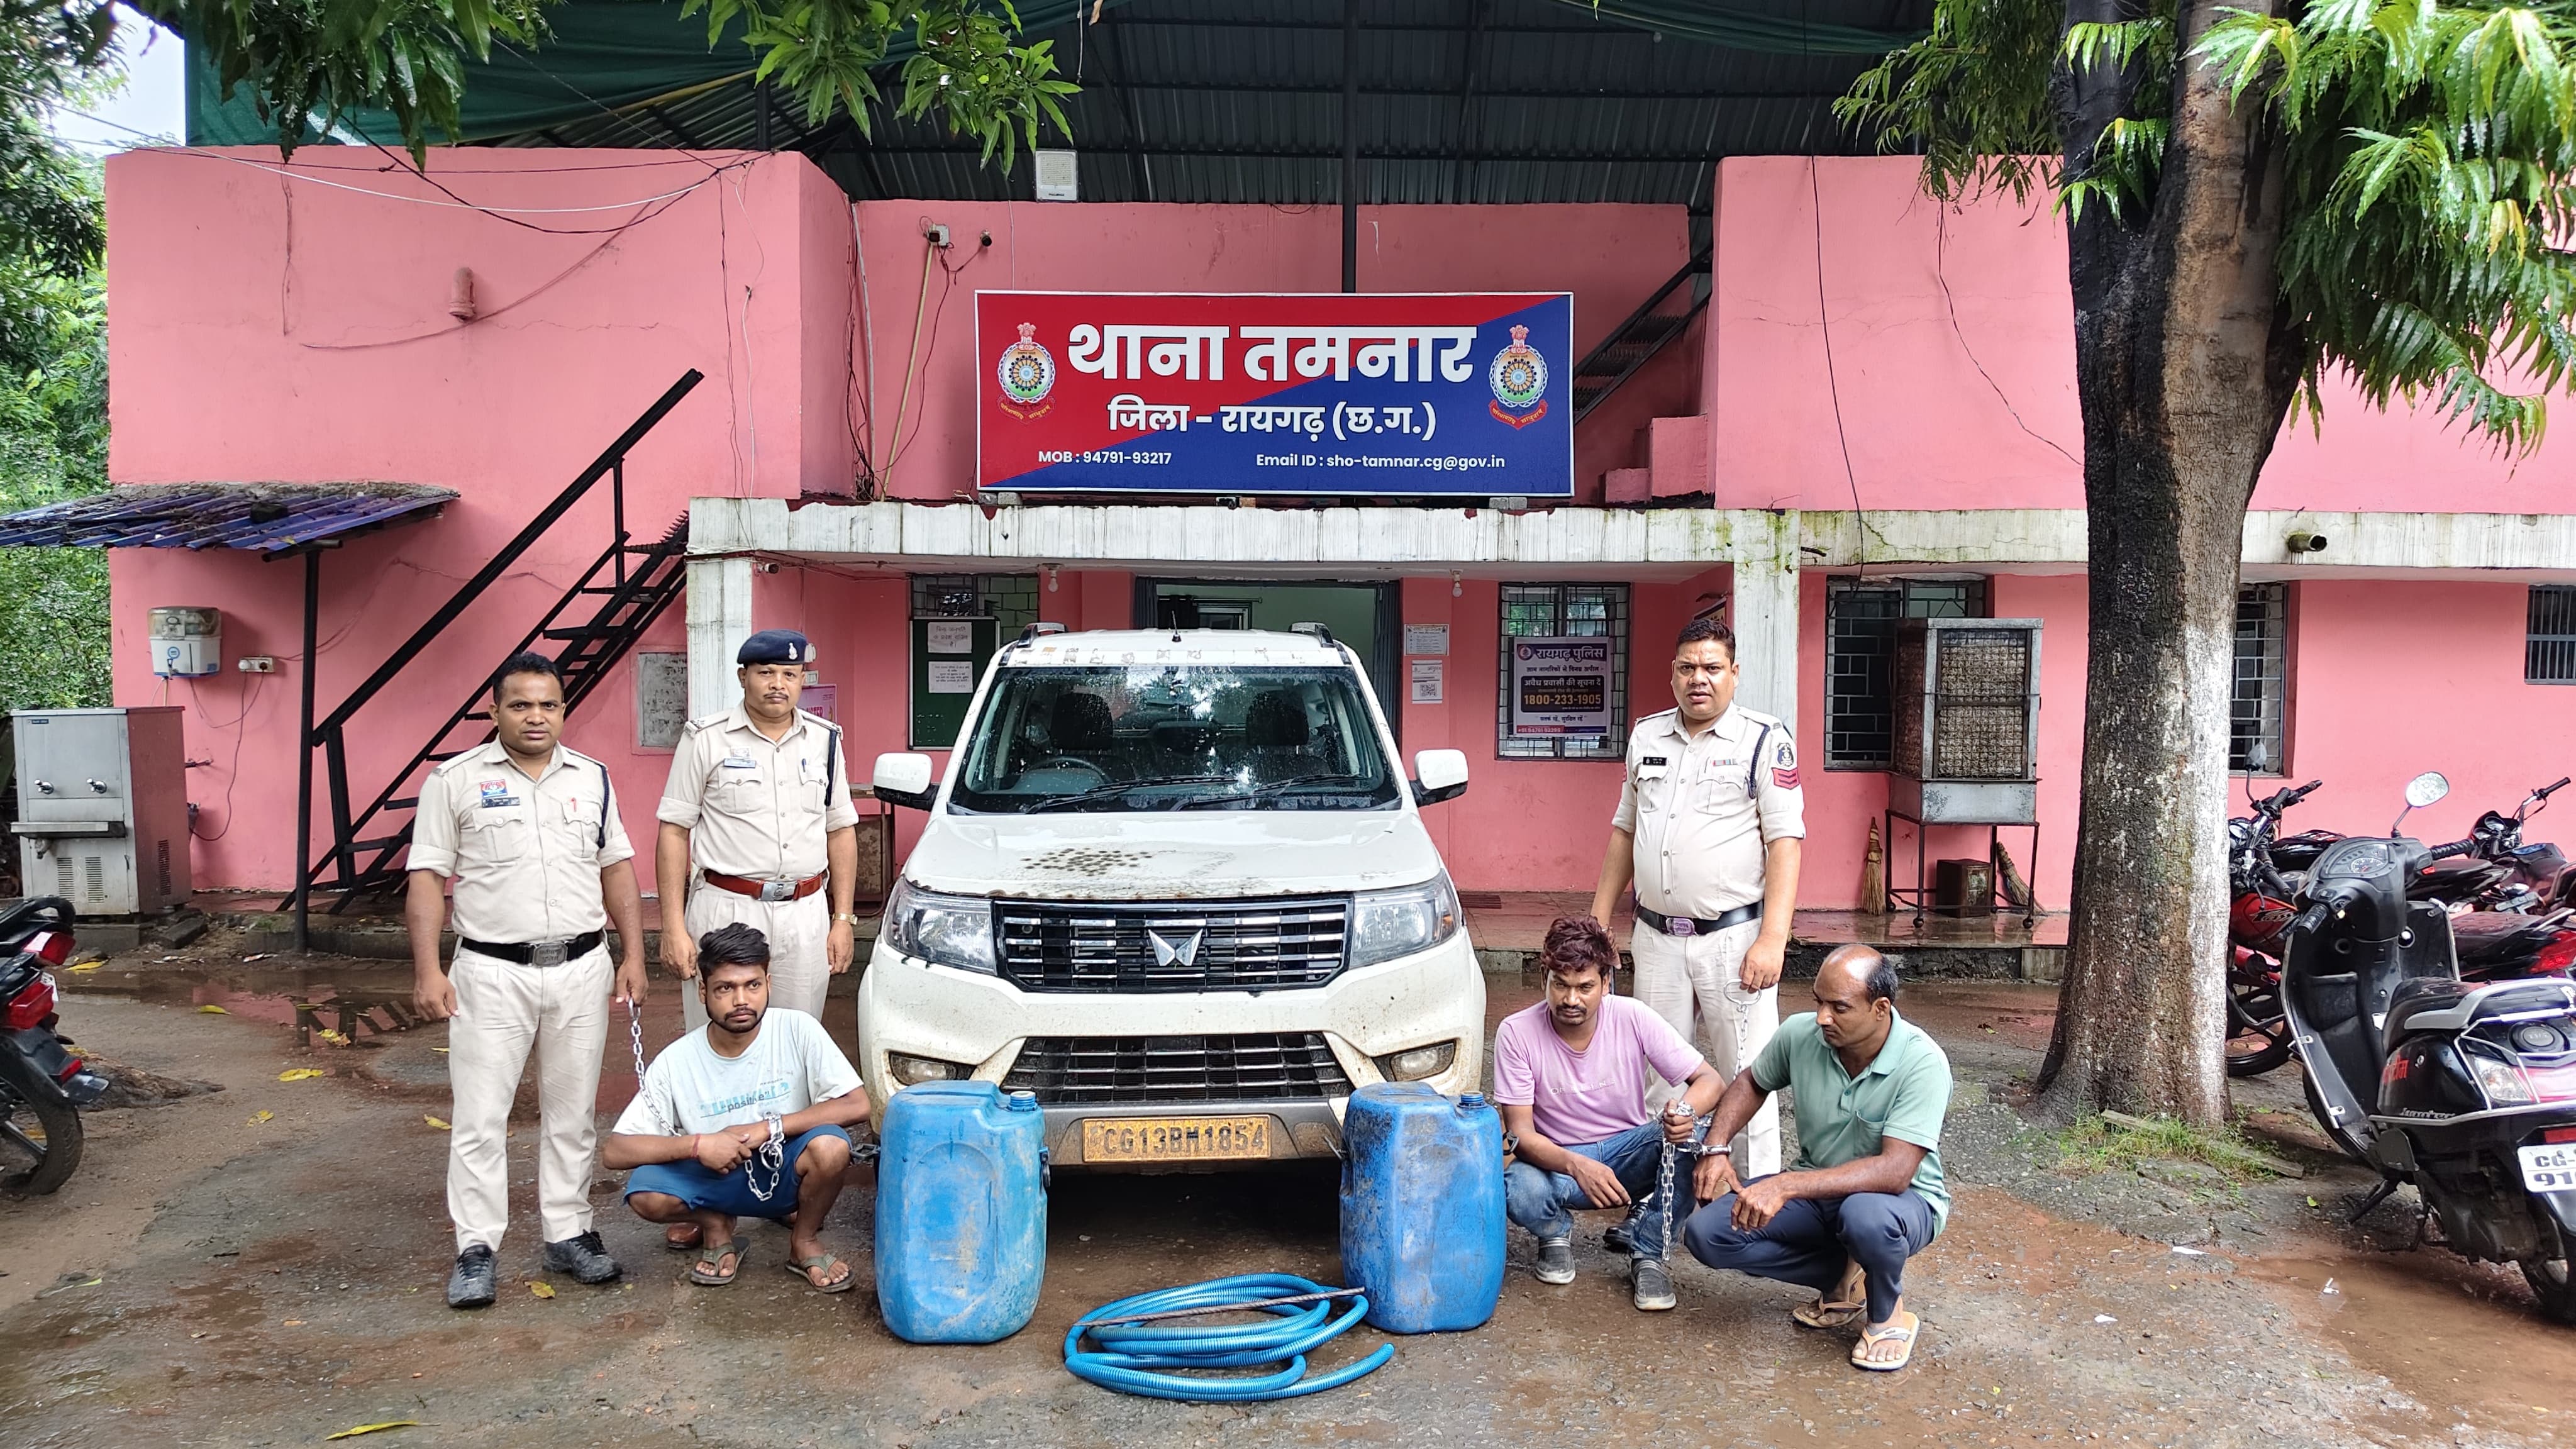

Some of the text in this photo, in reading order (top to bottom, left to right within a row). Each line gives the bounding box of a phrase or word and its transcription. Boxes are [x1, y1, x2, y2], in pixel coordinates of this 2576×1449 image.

[1068, 324, 1477, 383] थाना तमनार
[1107, 394, 1191, 432] जिला
[1220, 405, 1326, 442] रायगढ़
[1333, 401, 1436, 441] (छ.ग.)
[1038, 451, 1073, 463] MOB
[1083, 451, 1172, 465] 94791-93217
[1256, 453, 1298, 467] Email
[1301, 454, 1316, 467] ID
[1326, 454, 1505, 471] sho-tamnar.cg@gov.in
[1536, 646, 1604, 662] रायगढ़ पुलिस
[1524, 677, 1541, 686] अवैध
[1543, 677, 1565, 687] प्रवासी
[1566, 677, 1575, 686] की
[1577, 679, 1595, 687] सूचना
[1524, 694, 1601, 705] 1800-233-1905
[2533, 1171, 2576, 1187] 91
